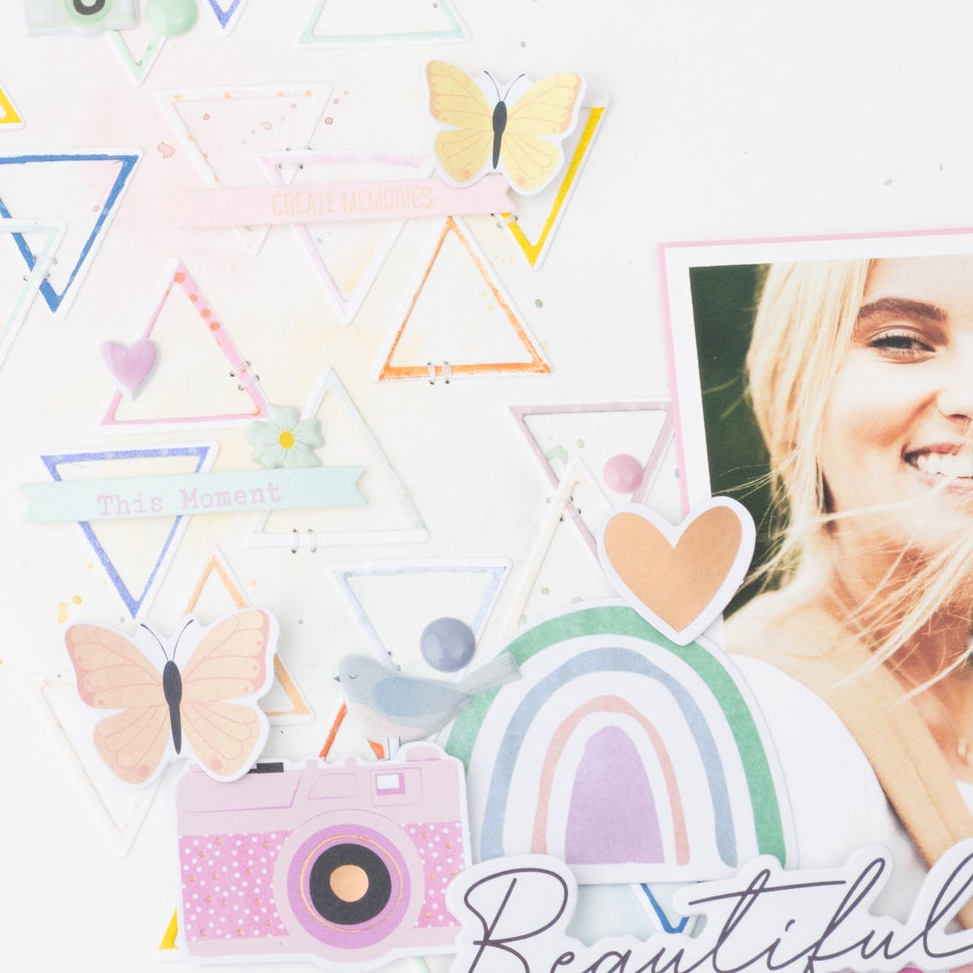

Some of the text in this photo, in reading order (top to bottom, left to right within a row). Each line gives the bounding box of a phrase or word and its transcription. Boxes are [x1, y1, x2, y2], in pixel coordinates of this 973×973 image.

[271, 186, 434, 216] CREATE MEMORIES
[97, 481, 283, 516] This Moment
[463, 852, 973, 973] Beautiful
